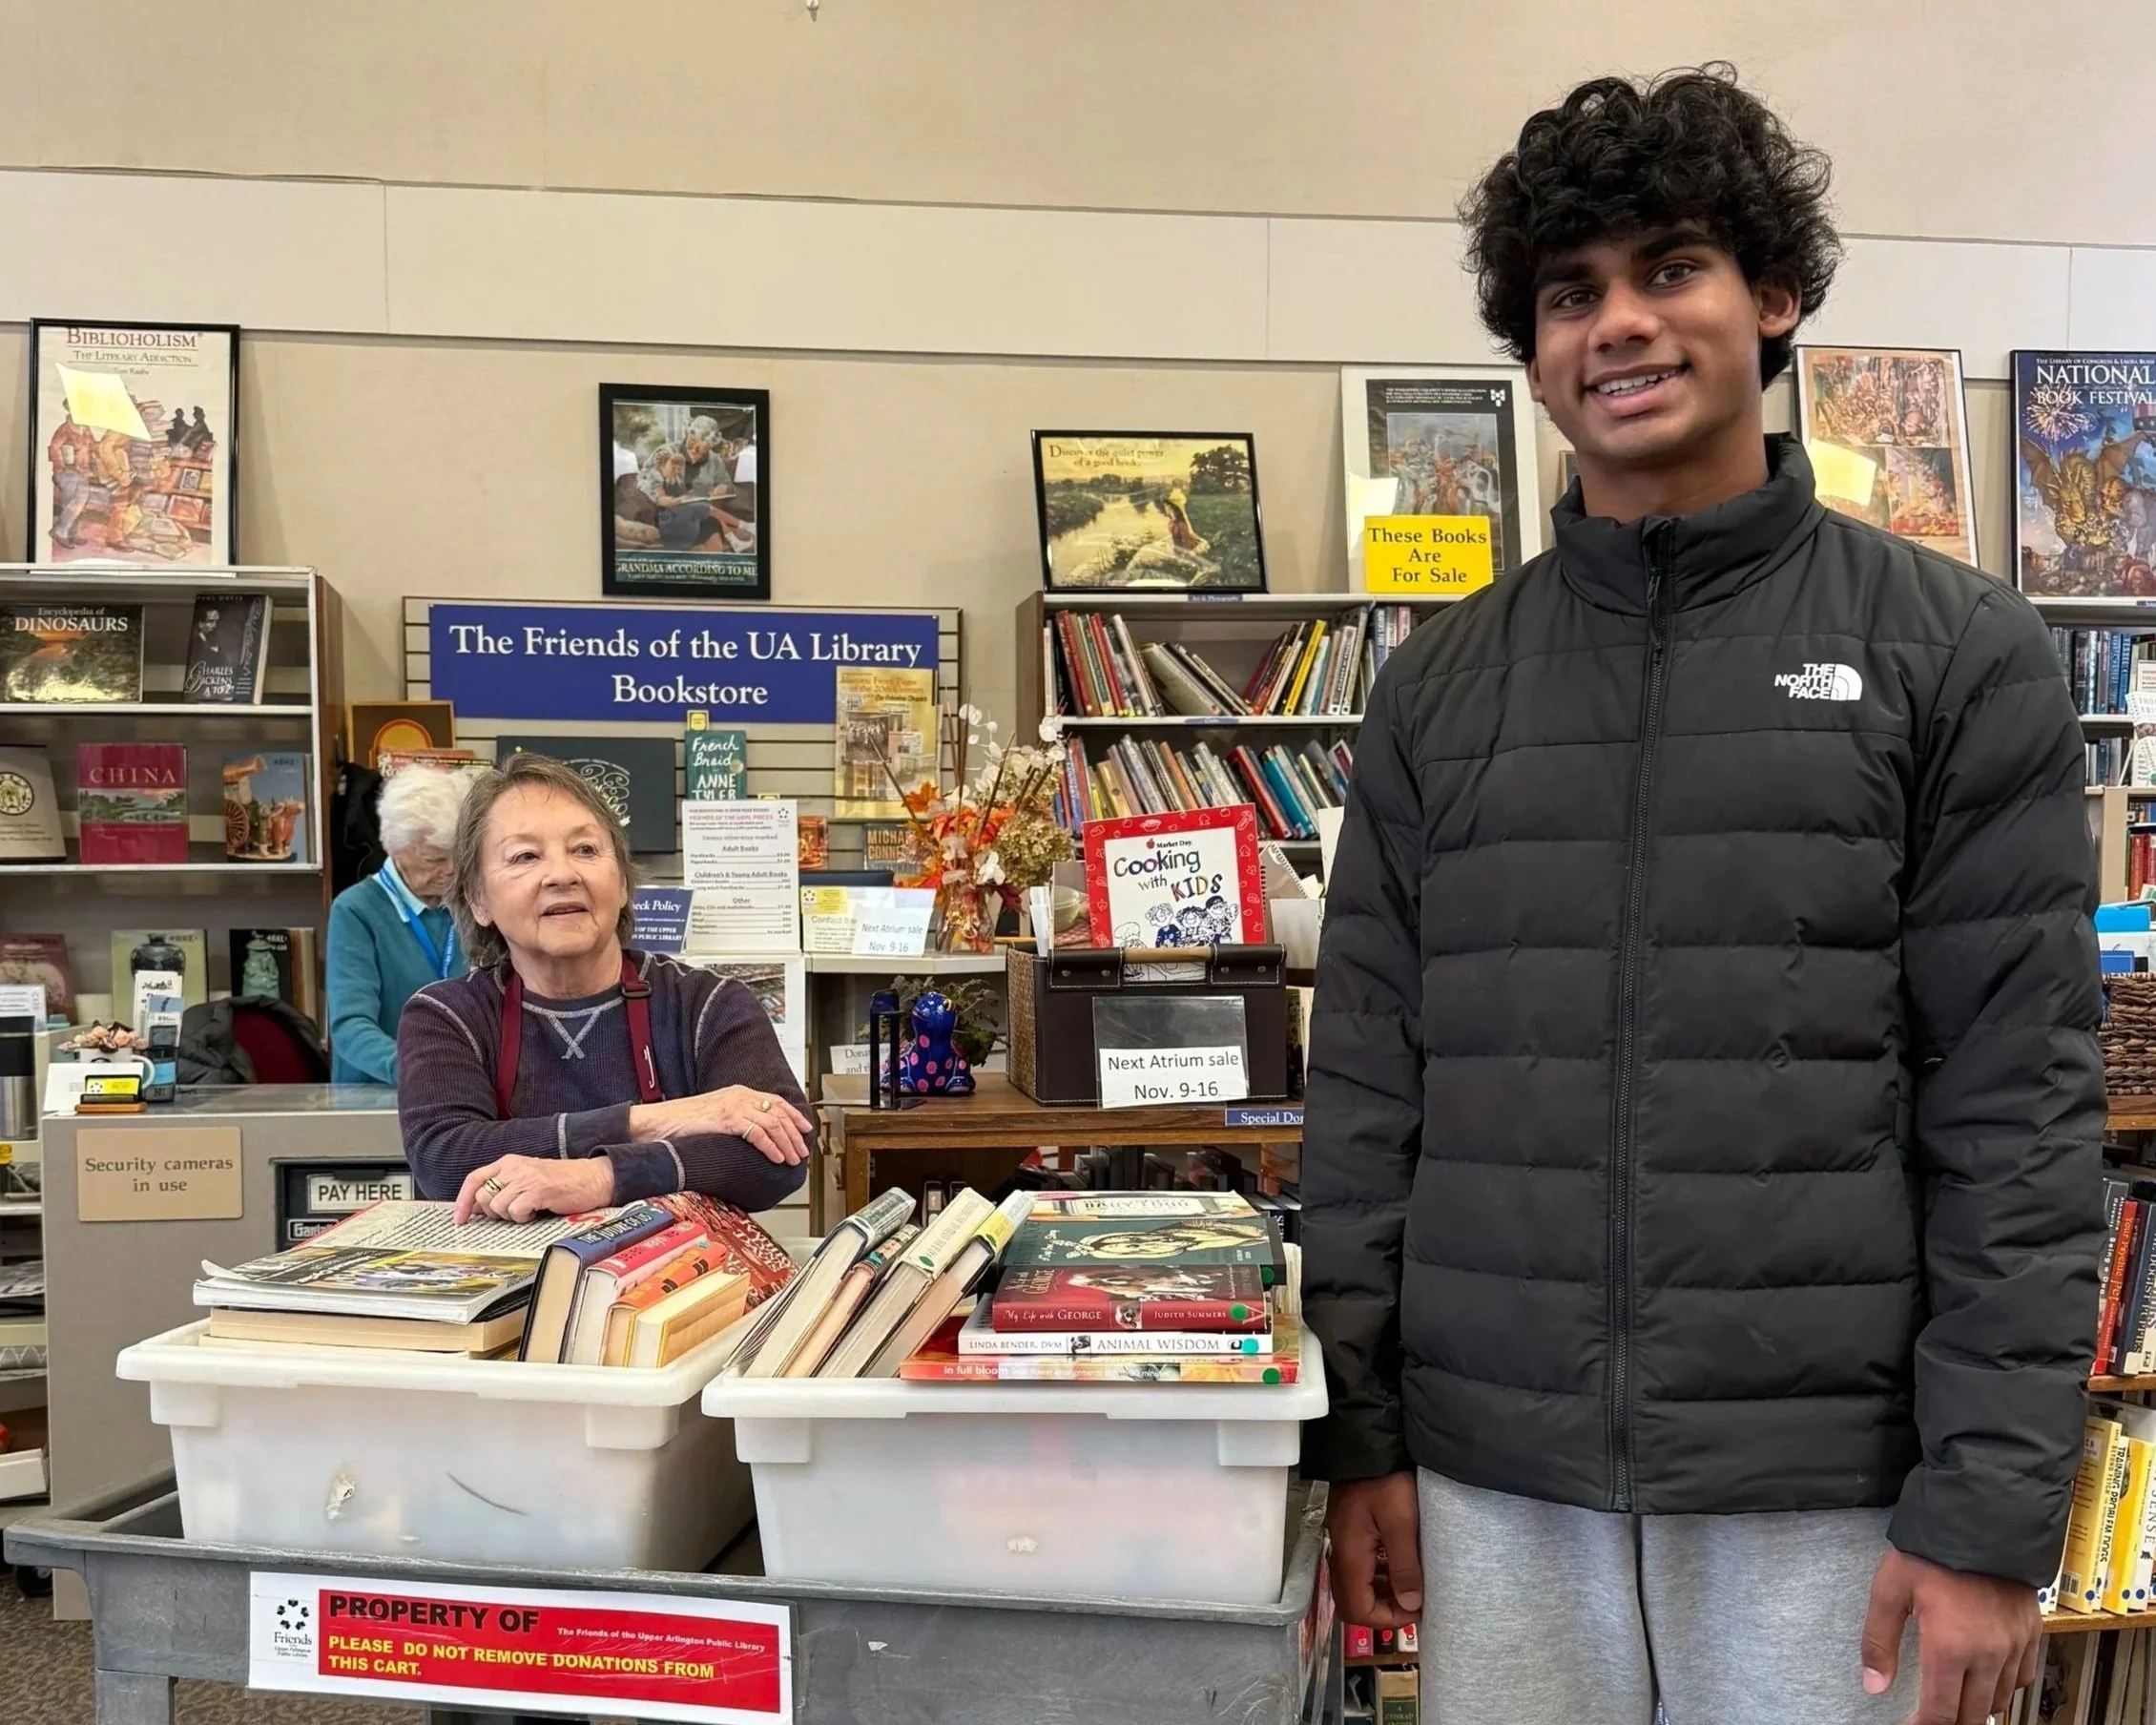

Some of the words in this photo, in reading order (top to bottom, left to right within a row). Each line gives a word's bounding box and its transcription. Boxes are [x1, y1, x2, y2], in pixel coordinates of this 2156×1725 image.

[67, 327, 196, 347] BIBLIOHOLISM
[73, 350, 92, 359] THE
[95, 351, 137, 362] LITERARY
[140, 352, 192, 363] ADDICTION
[2036, 364, 2156, 384] NATIONAL
[2036, 390, 2083, 405] BOOK
[2089, 390, 2156, 406] FESTIVAL
[1368, 528, 1422, 543] These
[1431, 529, 1487, 544] Books
[1408, 548, 1441, 562] Are
[616, 562, 664, 573] GRANDMA
[665, 563, 725, 574] ACCORDING
[728, 565, 741, 574] TO
[1392, 568, 1421, 583] For
[1430, 568, 1467, 583] Sale
[38, 607, 95, 617] Encyclopedia
[96, 607, 105, 616] of
[14, 616, 128, 632] DINOSAURS
[449, 625, 513, 655] The
[522, 627, 639, 657] Friends
[649, 630, 681, 657] of
[690, 631, 738, 658] the
[747, 632, 801, 660] UA
[809, 633, 923, 667] Library
[190, 660, 235, 682] CHARLES
[1803, 663, 1835, 675] THE
[1774, 674, 1834, 687] NORTH
[612, 674, 768, 705] Bookstore
[1789, 685, 1832, 699] FACE
[692, 734, 740, 752] French
[694, 752, 734, 767] Braid
[90, 767, 176, 784] CHINA
[697, 773, 737, 789] ANNE
[867, 830, 907, 844] MICHA
[1113, 850, 1201, 878] Cooking
[1138, 874, 1168, 891] with
[1171, 873, 1223, 903] KIDS
[632, 900, 650, 910] eck
[652, 900, 682, 913] Policy
[862, 924, 880, 932] Next
[881, 924, 905, 933] Atrium
[908, 924, 923, 935] sale
[846, 1063, 862, 1073] and
[1109, 1056, 1146, 1070] Next
[1151, 1053, 1205, 1069] Atrium
[1209, 1051, 1239, 1067] sale
[1134, 1083, 1173, 1100] Nov.
[1179, 1081, 1218, 1098] 9-16
[1240, 1112, 1280, 1127] Special
[86, 1157, 156, 1175] Security
[164, 1157, 234, 1171] cameras
[134, 1178, 150, 1192] in
[159, 1179, 188, 1192] use
[319, 1184, 350, 1201] PAY
[355, 1184, 403, 1200] HERE
[2123, 1217, 2134, 1237] Your
[576, 1232, 602, 1245] THE
[2104, 1237, 2117, 1264] Being
[2115, 1240, 2129, 1277] Psychic
[2107, 1278, 2124, 1302] Pet
[1005, 1309, 1019, 1322] My
[1039, 1311, 1054, 1320] with
[1057, 1309, 1102, 1320] GEORGE
[1154, 1310, 1184, 1319] JUDITH
[1187, 1310, 1227, 1319] SUMMERS
[969, 1341, 998, 1349] LINDA
[1041, 1341, 1062, 1349] DVM
[1097, 1339, 1152, 1350] ANIMAL
[1157, 1339, 1220, 1350] WISDOM
[943, 1366, 954, 1375] in
[957, 1365, 973, 1375] full
[975, 1366, 1008, 1375] bloom
[2112, 1446, 2126, 1489] TRAINING
[2100, 1535, 2111, 1563] DOGS
[329, 1594, 488, 1630] PROPERTY
[499, 1609, 539, 1633] OF
[275, 1631, 312, 1645] Friends
[557, 1628, 574, 1637] The
[576, 1628, 609, 1638] Friends
[610, 1630, 620, 1638] of
[621, 1630, 636, 1639] the
[637, 1632, 664, 1644] Upper
[666, 1633, 704, 1646] Arlington
[706, 1638, 732, 1649] Public
[735, 1640, 766, 1652] Library
[328, 1634, 394, 1654] PLEASE
[404, 1642, 427, 1657] DO
[433, 1644, 468, 1661] NOT
[473, 1648, 547, 1667] REMOVE
[553, 1653, 658, 1673] DONATIONS
[664, 1661, 715, 1679] FROM
[328, 1654, 368, 1671] THIS
[374, 1658, 422, 1676] CART.
